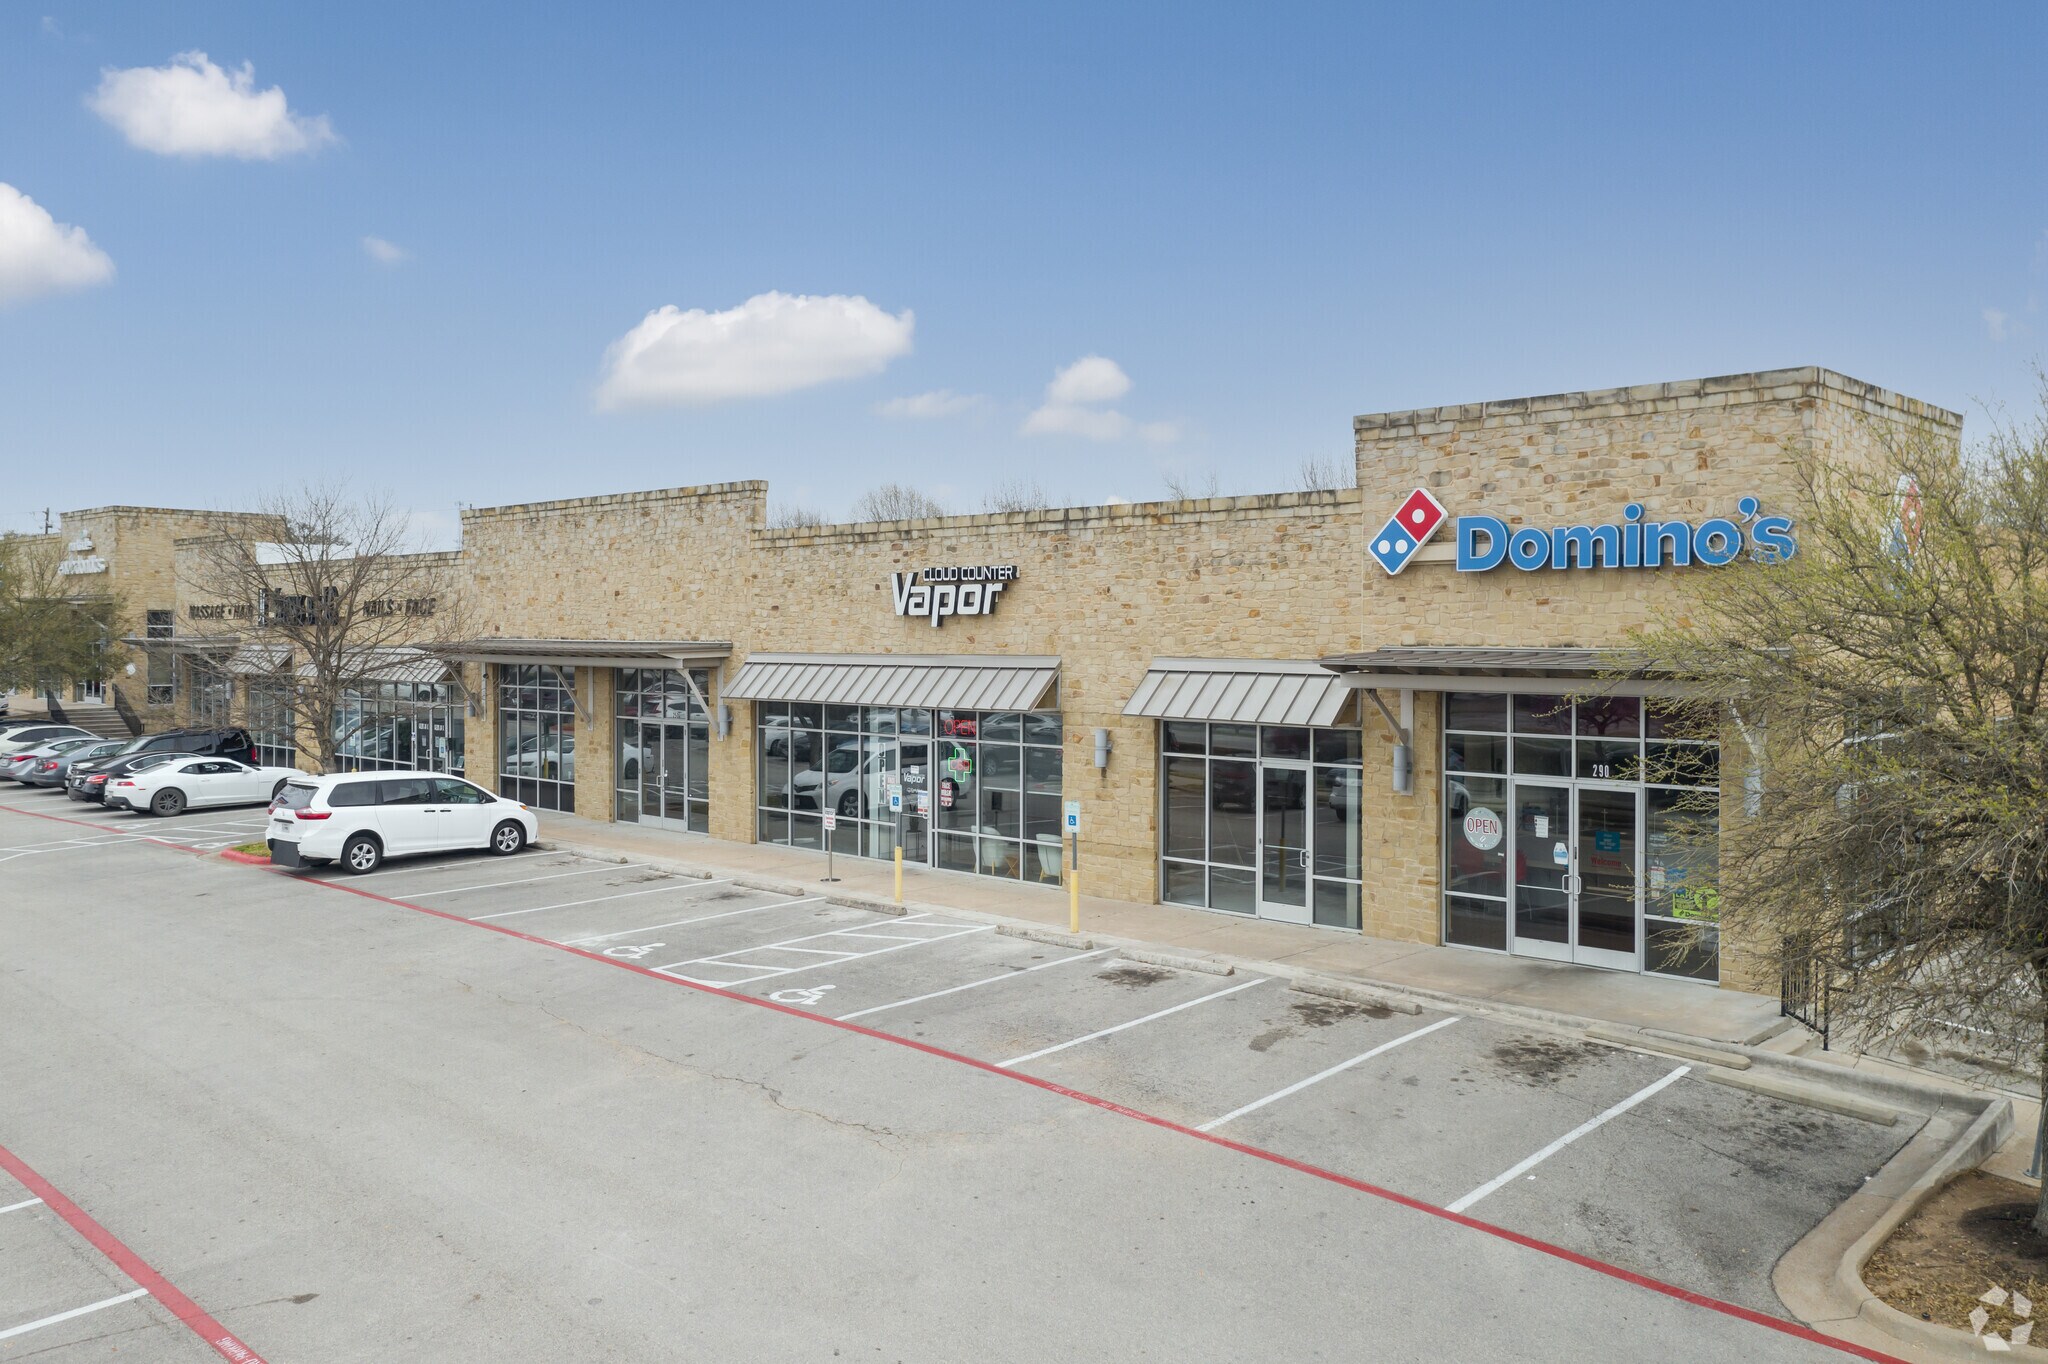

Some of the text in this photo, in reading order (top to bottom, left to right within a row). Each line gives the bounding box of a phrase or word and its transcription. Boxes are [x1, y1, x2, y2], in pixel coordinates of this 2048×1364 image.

[1456, 496, 1797, 572] Domino's
[923, 565, 1014, 582] CLOUD COUNTER
[890, 571, 1008, 628] Vapor
[944, 719, 977, 735] OPEN
[903, 772, 926, 784] Vapor
[1592, 764, 1610, 778] 290
[1466, 816, 1498, 835] OPEN
